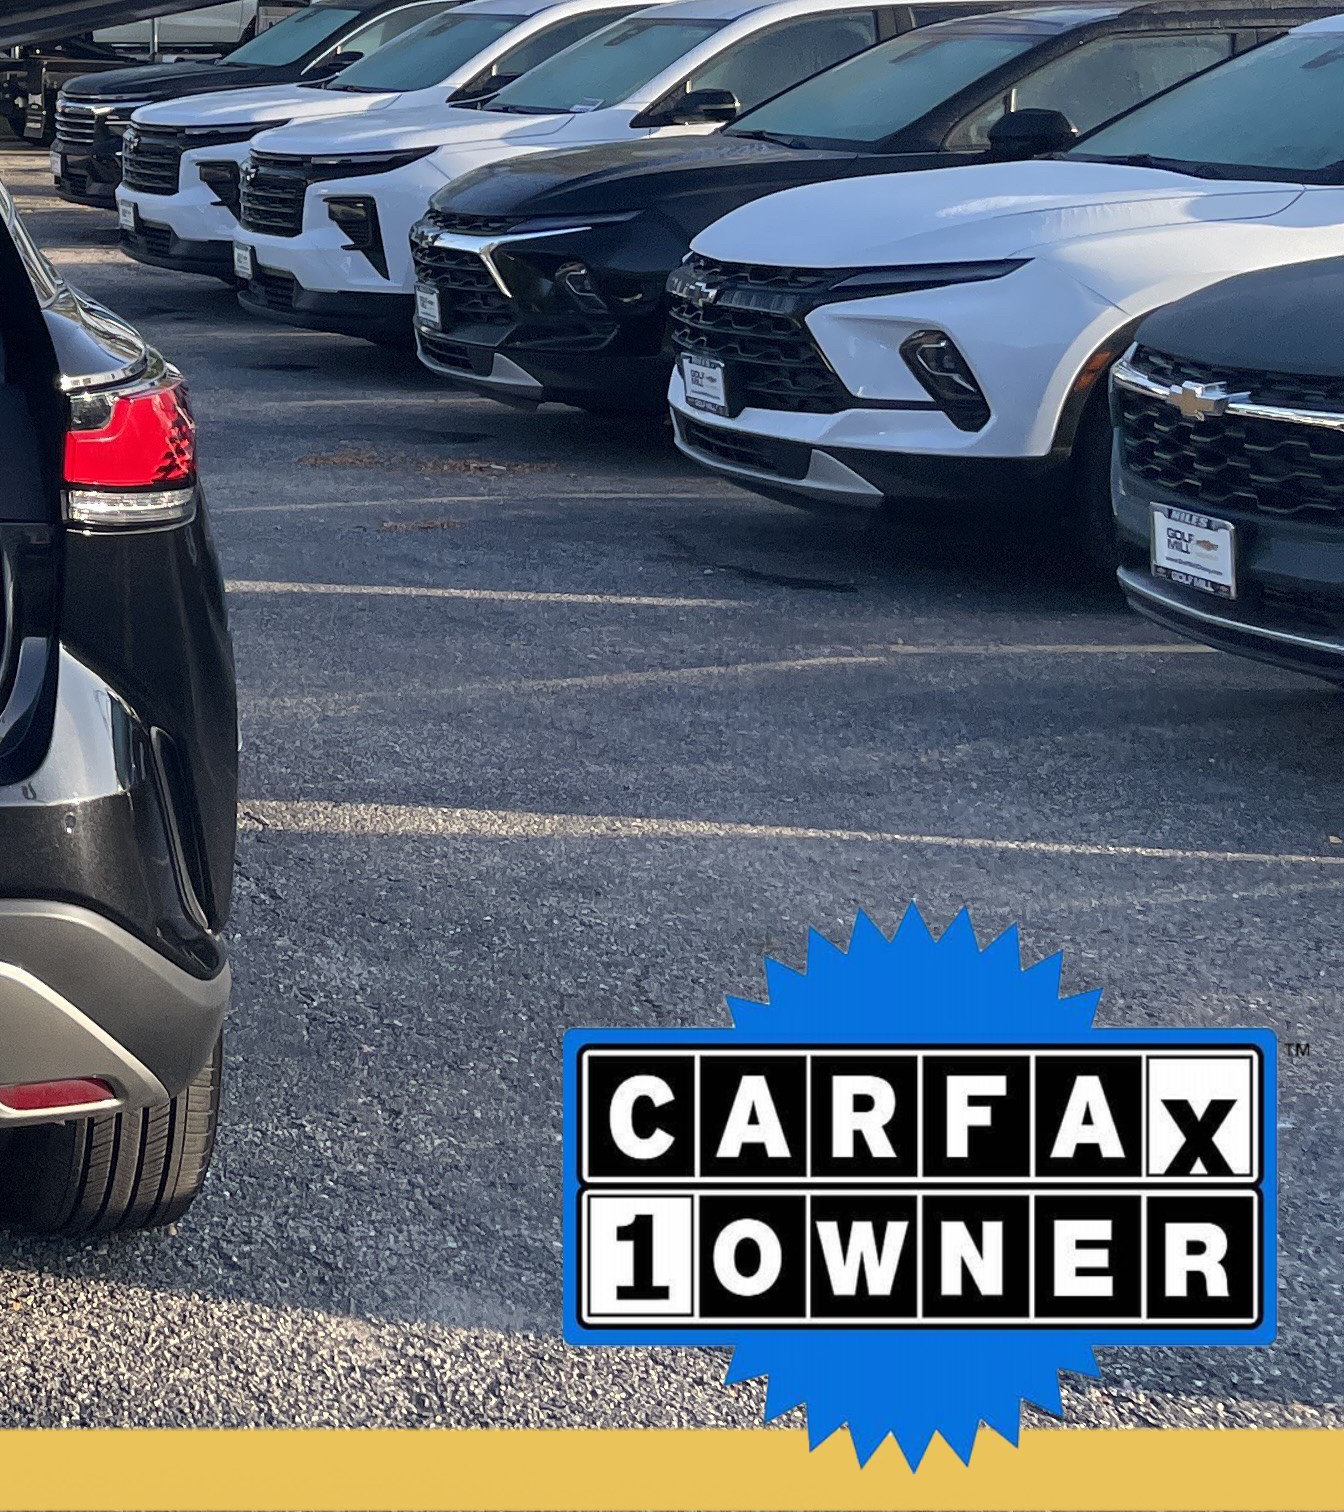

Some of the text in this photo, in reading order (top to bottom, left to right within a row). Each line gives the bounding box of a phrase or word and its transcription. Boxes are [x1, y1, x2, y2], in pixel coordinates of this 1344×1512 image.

[1171, 509, 1209, 528] NILES
[1166, 527, 1194, 544] GOLF
[1167, 538, 1191, 555] MILL
